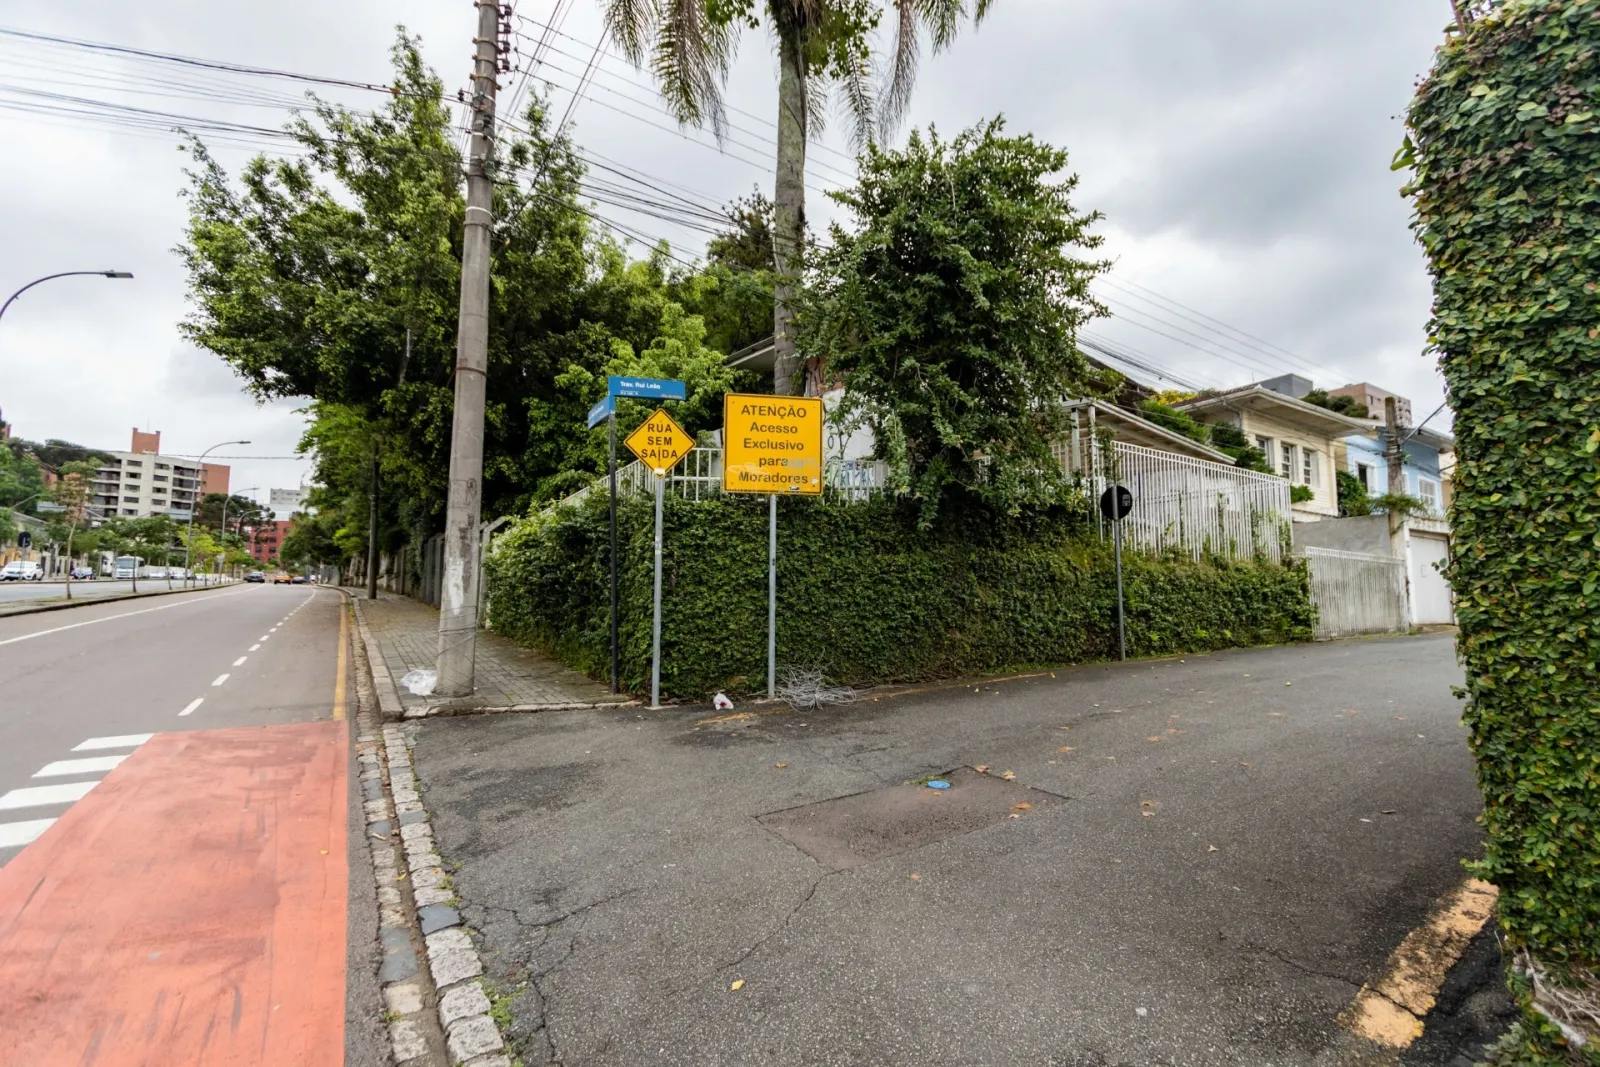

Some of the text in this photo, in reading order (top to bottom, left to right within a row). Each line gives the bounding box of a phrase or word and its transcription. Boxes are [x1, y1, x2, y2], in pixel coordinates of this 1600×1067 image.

[741, 404, 806, 419] ATENÇÃO
[648, 424, 672, 432] RUA
[750, 422, 798, 434] Acesso
[648, 436, 672, 446] SEM
[744, 438, 804, 450] Exclusivo
[641, 447, 678, 458] SAÍDA
[759, 457, 788, 467] para
[739, 472, 808, 484] Moradores
